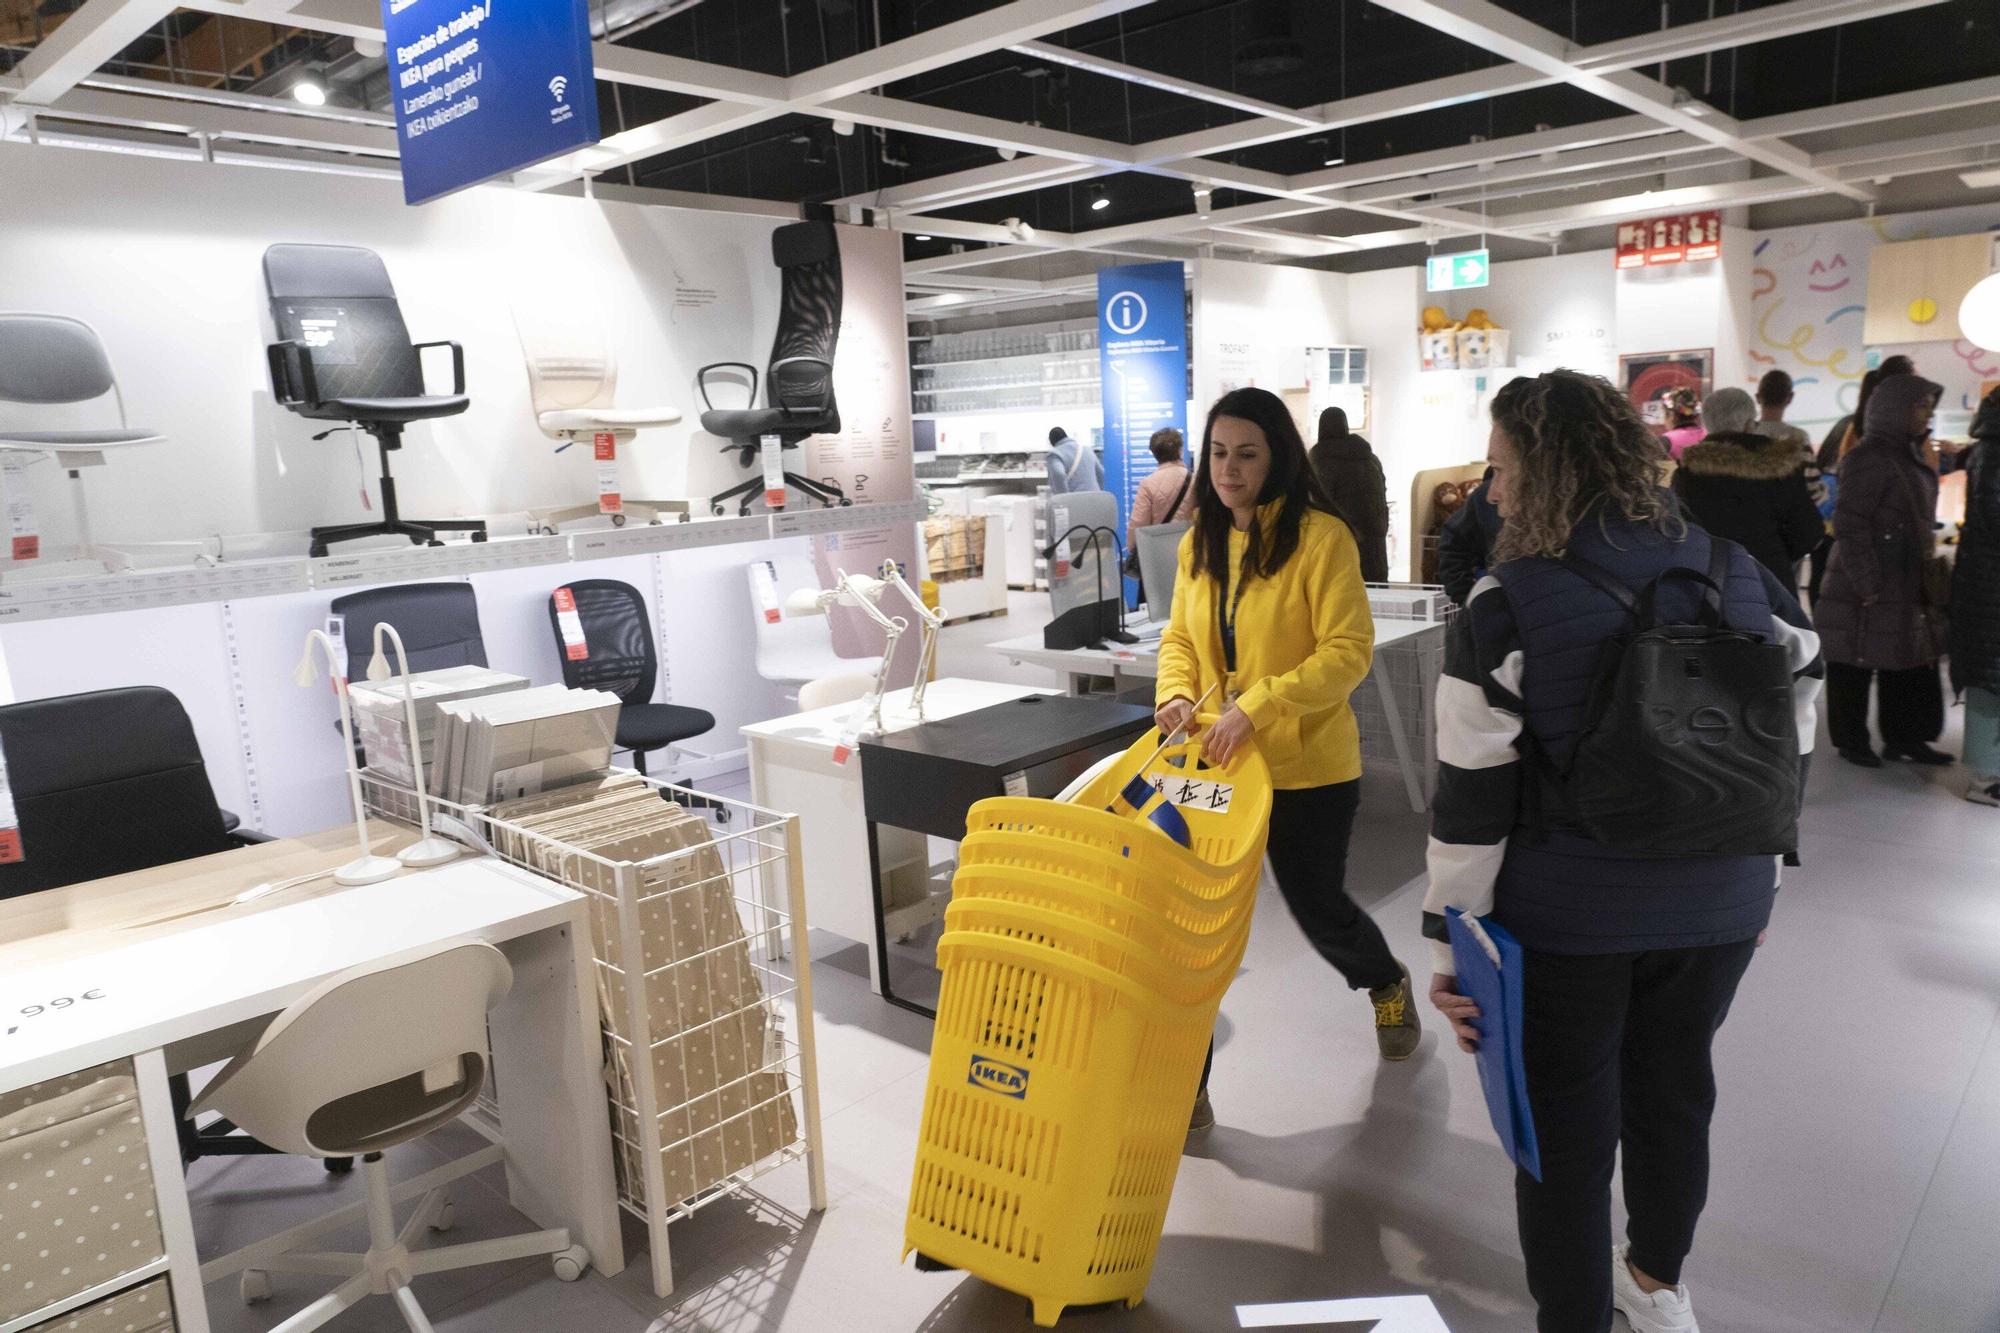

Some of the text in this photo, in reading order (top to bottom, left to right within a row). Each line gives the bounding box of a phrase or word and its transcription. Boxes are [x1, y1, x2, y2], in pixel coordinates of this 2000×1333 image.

[397, 33, 437, 65] Espacios
[436, 25, 450, 44] de
[448, 5, 485, 37] trabajo
[400, 38, 479, 88] IKEA para peques
[403, 85, 444, 115] Lanerako
[444, 66, 478, 101] guneak
[406, 117, 428, 139] IKEA
[975, 1064, 1021, 1089] IKEA
